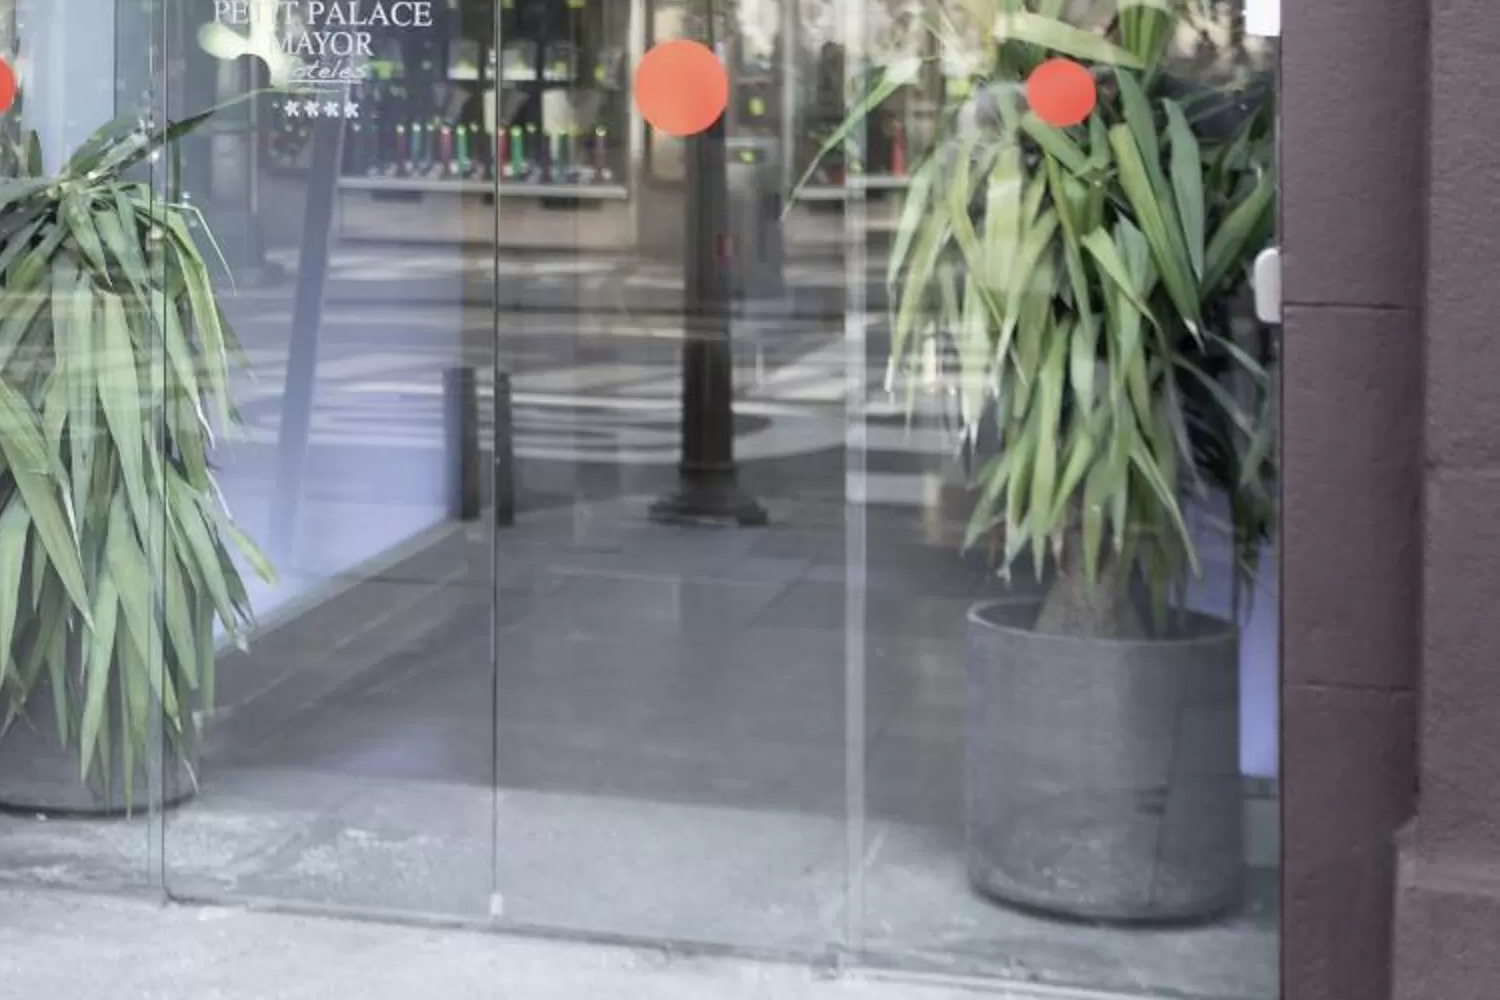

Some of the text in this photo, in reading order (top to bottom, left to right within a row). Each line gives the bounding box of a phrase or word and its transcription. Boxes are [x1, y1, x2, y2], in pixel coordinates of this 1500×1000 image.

[213, 0, 433, 27] PET PALACE
[270, 31, 373, 57] MAYOR
[285, 60, 370, 80] oteles
